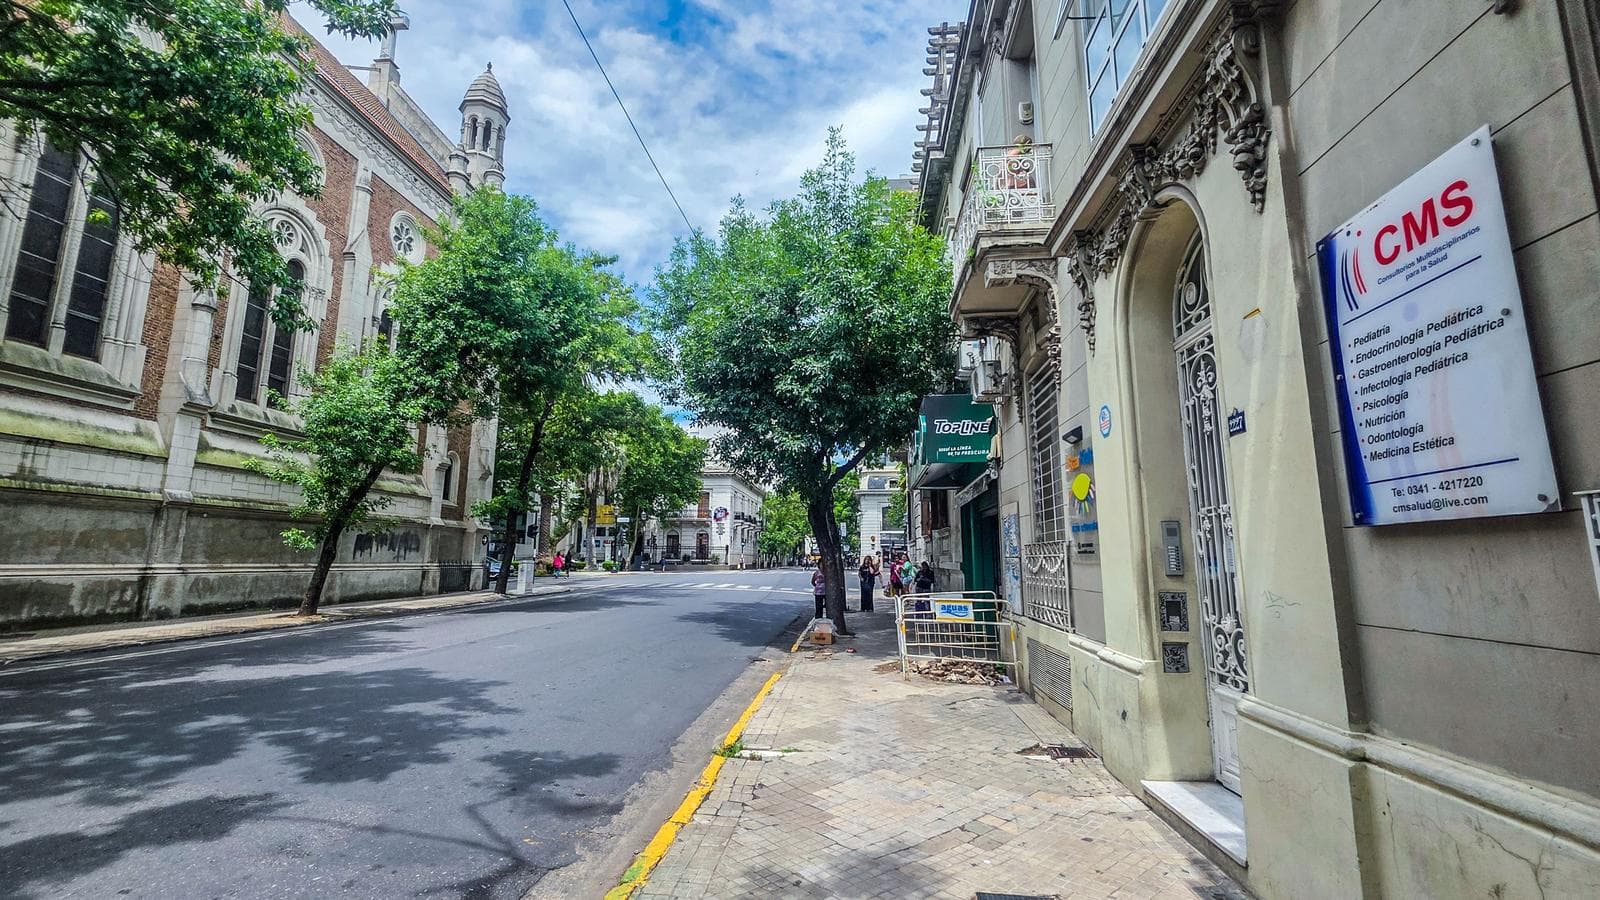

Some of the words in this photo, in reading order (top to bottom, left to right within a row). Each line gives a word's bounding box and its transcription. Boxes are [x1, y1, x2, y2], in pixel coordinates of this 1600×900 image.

[1374, 180, 1473, 265] CMS
[1377, 261, 1415, 285] Consultorios
[1416, 225, 1480, 265] Multidisciplinarios
[1405, 269, 1420, 281] para
[1420, 264, 1427, 272] la
[1428, 253, 1448, 269] Salud
[1353, 324, 1391, 348] Pediatría
[1355, 329, 1424, 364] Endocrinología
[1426, 304, 1484, 335] Pediátrica
[1358, 340, 1441, 380] Gastroenterología
[1444, 317, 1505, 348] Pediátrica
[1414, 352, 1468, 378] Pediátrica
[1363, 390, 1409, 412] Psicología
[1365, 410, 1406, 428] Nutrición
[1367, 423, 1424, 445] Odontología
[1370, 445, 1410, 462] Medicina
[1412, 436, 1455, 453] Estética
[1392, 488, 1405, 497] Te:
[1407, 484, 1429, 495] 0341
[1438, 475, 1483, 491] 4217220
[1392, 494, 1489, 513] cmsalud@live.com
[941, 604, 968, 614] aguas
